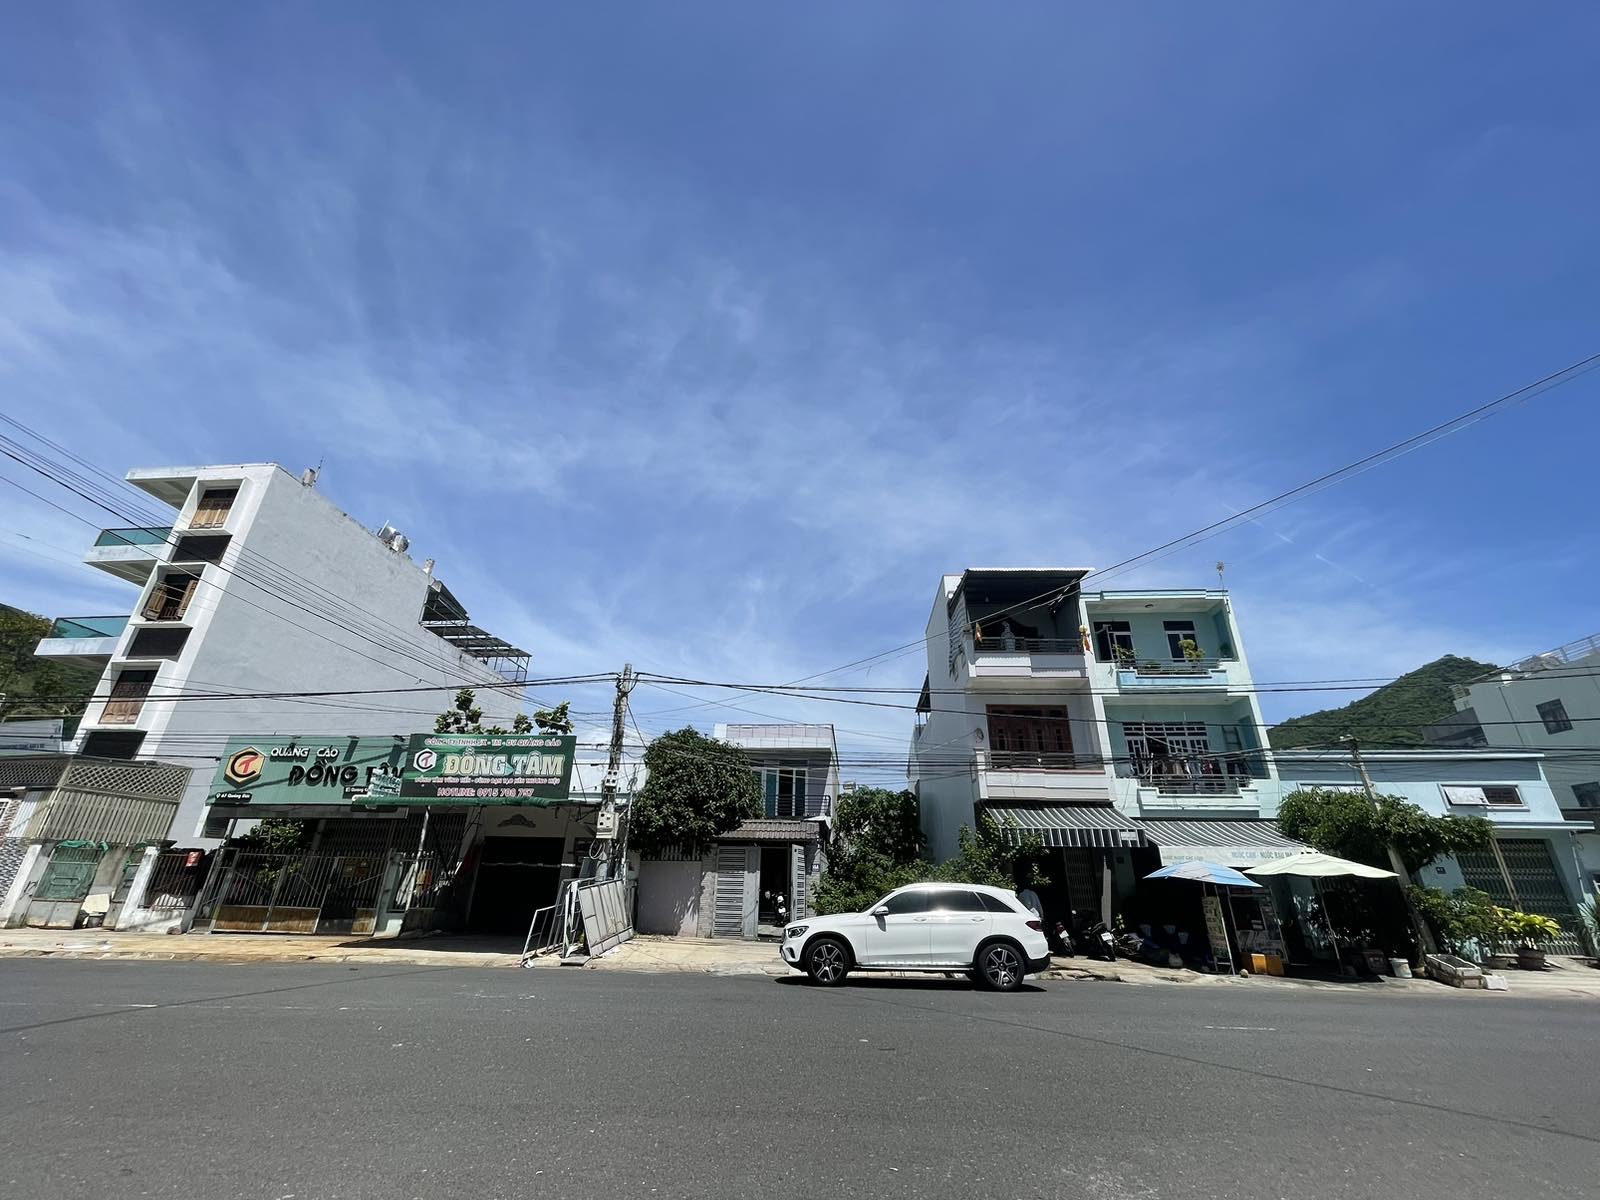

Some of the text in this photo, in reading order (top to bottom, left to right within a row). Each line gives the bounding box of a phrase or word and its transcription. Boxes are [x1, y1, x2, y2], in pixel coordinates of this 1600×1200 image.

[316, 745, 339, 758] CÁO
[288, 759, 359, 786] ĐỒNG
[511, 750, 565, 777] TÂM
[437, 787, 475, 797] HOTLINE:
[477, 788, 499, 797] 0915
